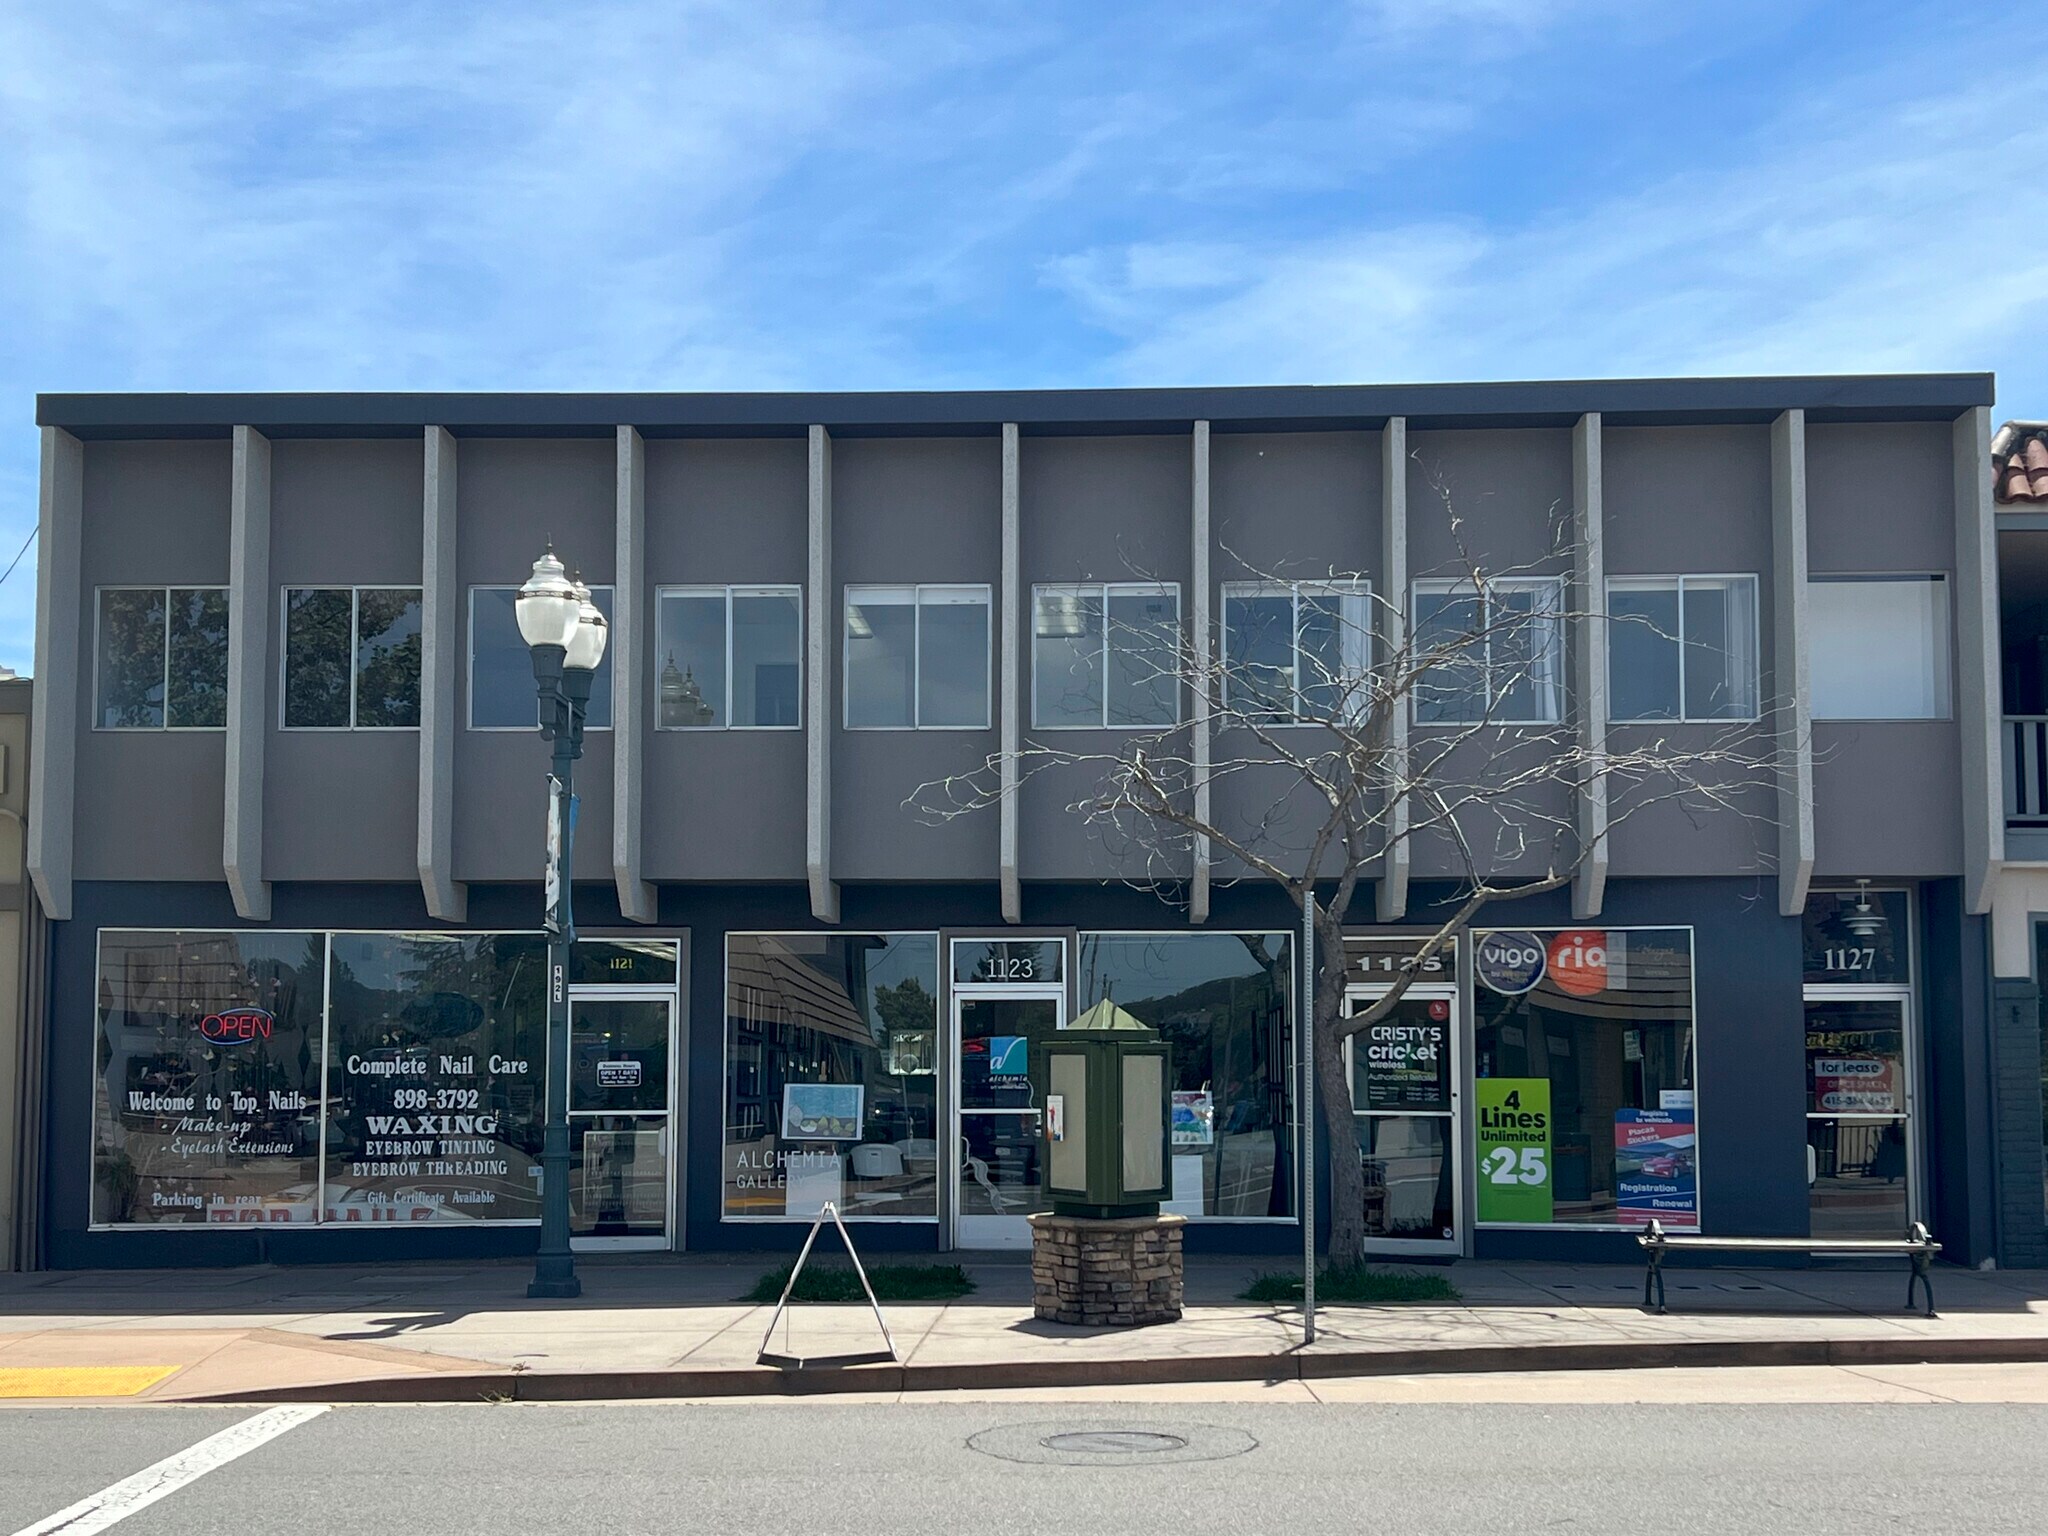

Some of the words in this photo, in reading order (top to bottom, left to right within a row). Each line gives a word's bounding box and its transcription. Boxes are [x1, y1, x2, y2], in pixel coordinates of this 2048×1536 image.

[1485, 943, 1539, 968] vigo
[1558, 936, 1607, 968] ria
[1824, 948, 1875, 971] 1127
[610, 958, 632, 970] 1121
[987, 958, 1033, 978] 1123
[554, 966, 562, 1001] 192L
[201, 1014, 272, 1039] OPEN
[1371, 1026, 1442, 1041] CRISTY'S
[1367, 1042, 1438, 1060] cricket
[347, 1055, 427, 1078] Complete
[440, 1055, 473, 1075] Nail
[488, 1055, 528, 1075] Care
[1368, 1060, 1406, 1070] wireless
[1843, 1062, 1879, 1073] lease
[128, 1091, 195, 1111] Welcome
[205, 1093, 222, 1111] to
[231, 1091, 258, 1115] Top
[268, 1091, 307, 1111] Nails
[393, 1089, 479, 1110] 898-3792
[1504, 1090, 1521, 1111] 4
[171, 1116, 251, 1138] Make-up
[365, 1115, 498, 1135] WAXING
[1481, 1106, 1547, 1129] Lines
[1481, 1131, 1547, 1143] Unlimited
[171, 1137, 225, 1160] Eyelash
[227, 1137, 294, 1155] Extensions
[366, 1141, 434, 1156] EYEBROW
[439, 1140, 496, 1155] TINTING
[353, 1162, 421, 1177] EYEBROW
[425, 1160, 508, 1176] THREADING
[736, 1150, 841, 1169] ALCHEMIA
[1480, 1146, 1548, 1186] $25
[367, 1191, 387, 1205] Gift
[393, 1191, 446, 1204] Certificate
[452, 1190, 496, 1204] Available
[1620, 1183, 1677, 1194] Registration
[152, 1191, 203, 1210] Parking
[212, 1193, 226, 1206] in
[235, 1193, 262, 1205] rear
[1651, 1199, 1693, 1208] Renewal
